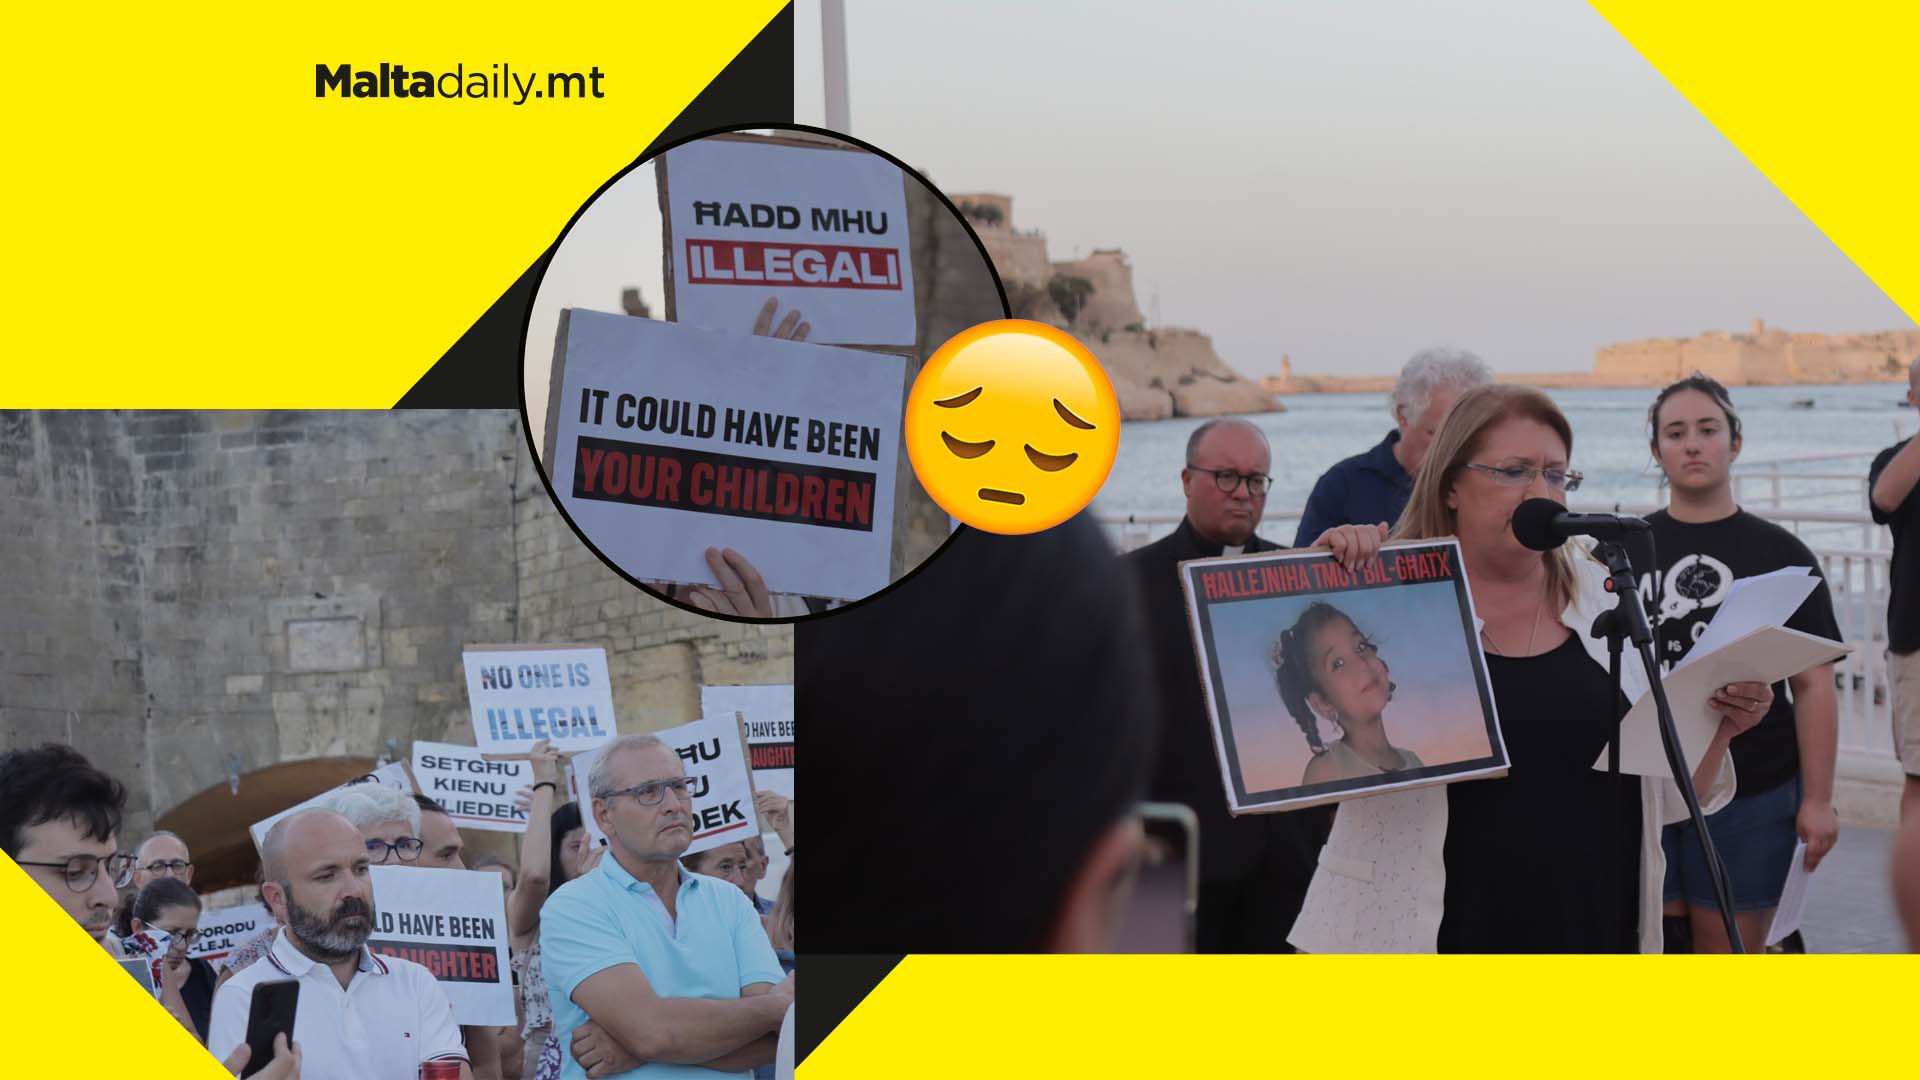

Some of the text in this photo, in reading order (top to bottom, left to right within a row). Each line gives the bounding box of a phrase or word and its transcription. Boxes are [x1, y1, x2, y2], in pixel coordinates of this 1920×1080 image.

[692, 201, 888, 235] ĦADD MHU
[688, 245, 899, 285] ILLEGALI
[579, 388, 880, 460] IT COULD HAVE BEEN
[580, 447, 873, 525] YOUR CHILDREN
[481, 662, 591, 690] NO ONE IS
[487, 705, 607, 740] ILLEGAL
[752, 721, 777, 738] HAVE
[434, 777, 505, 796] KIENU
[435, 798, 526, 820] LIEDEK
[200, 920, 255, 937] ORQDU
[399, 912, 445, 937] HAVE
[449, 916, 495, 939] BEEN
